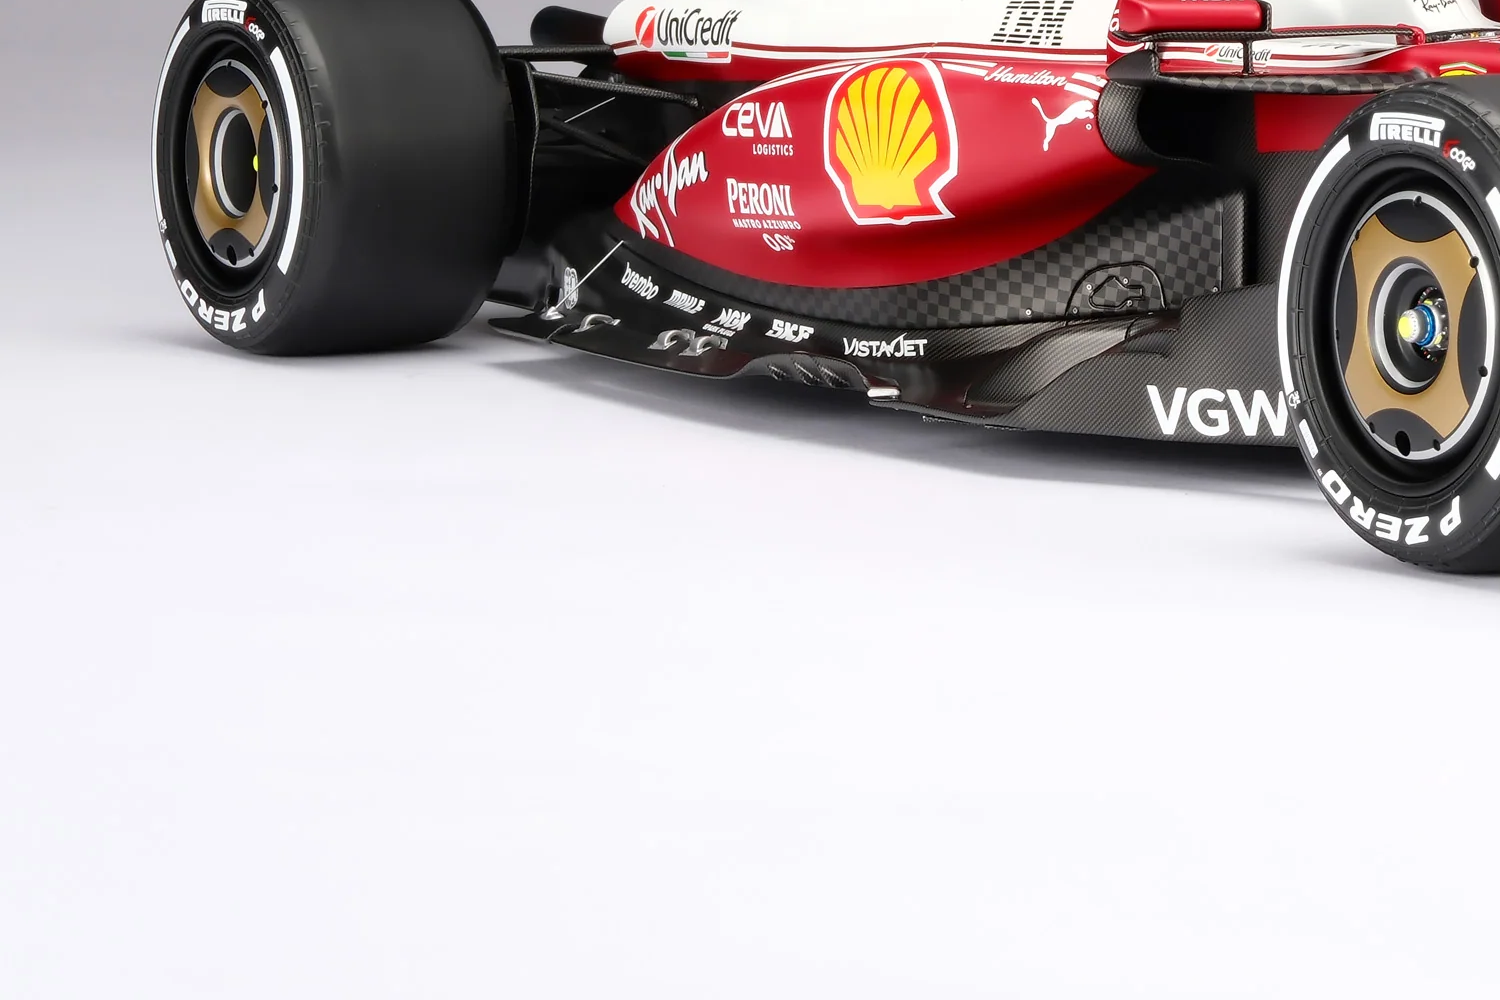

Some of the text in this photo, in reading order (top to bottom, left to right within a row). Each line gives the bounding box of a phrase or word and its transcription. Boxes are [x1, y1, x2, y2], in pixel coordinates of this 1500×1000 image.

[657, 7, 742, 47] UniCredit
[990, 0, 1074, 46] IBM
[983, 65, 1068, 87] Hamilton
[752, 143, 794, 156] LOGISTICS
[1369, 112, 1446, 148] PIRELLI
[726, 177, 795, 217] PERONI
[732, 218, 802, 230] NASTRO AZZURRO
[621, 261, 660, 301] brembo
[180, 279, 267, 333] P ZERO
[765, 318, 815, 344] SKF
[1146, 384, 1289, 437] VGW
[1321, 469, 1463, 546] P ZERO
